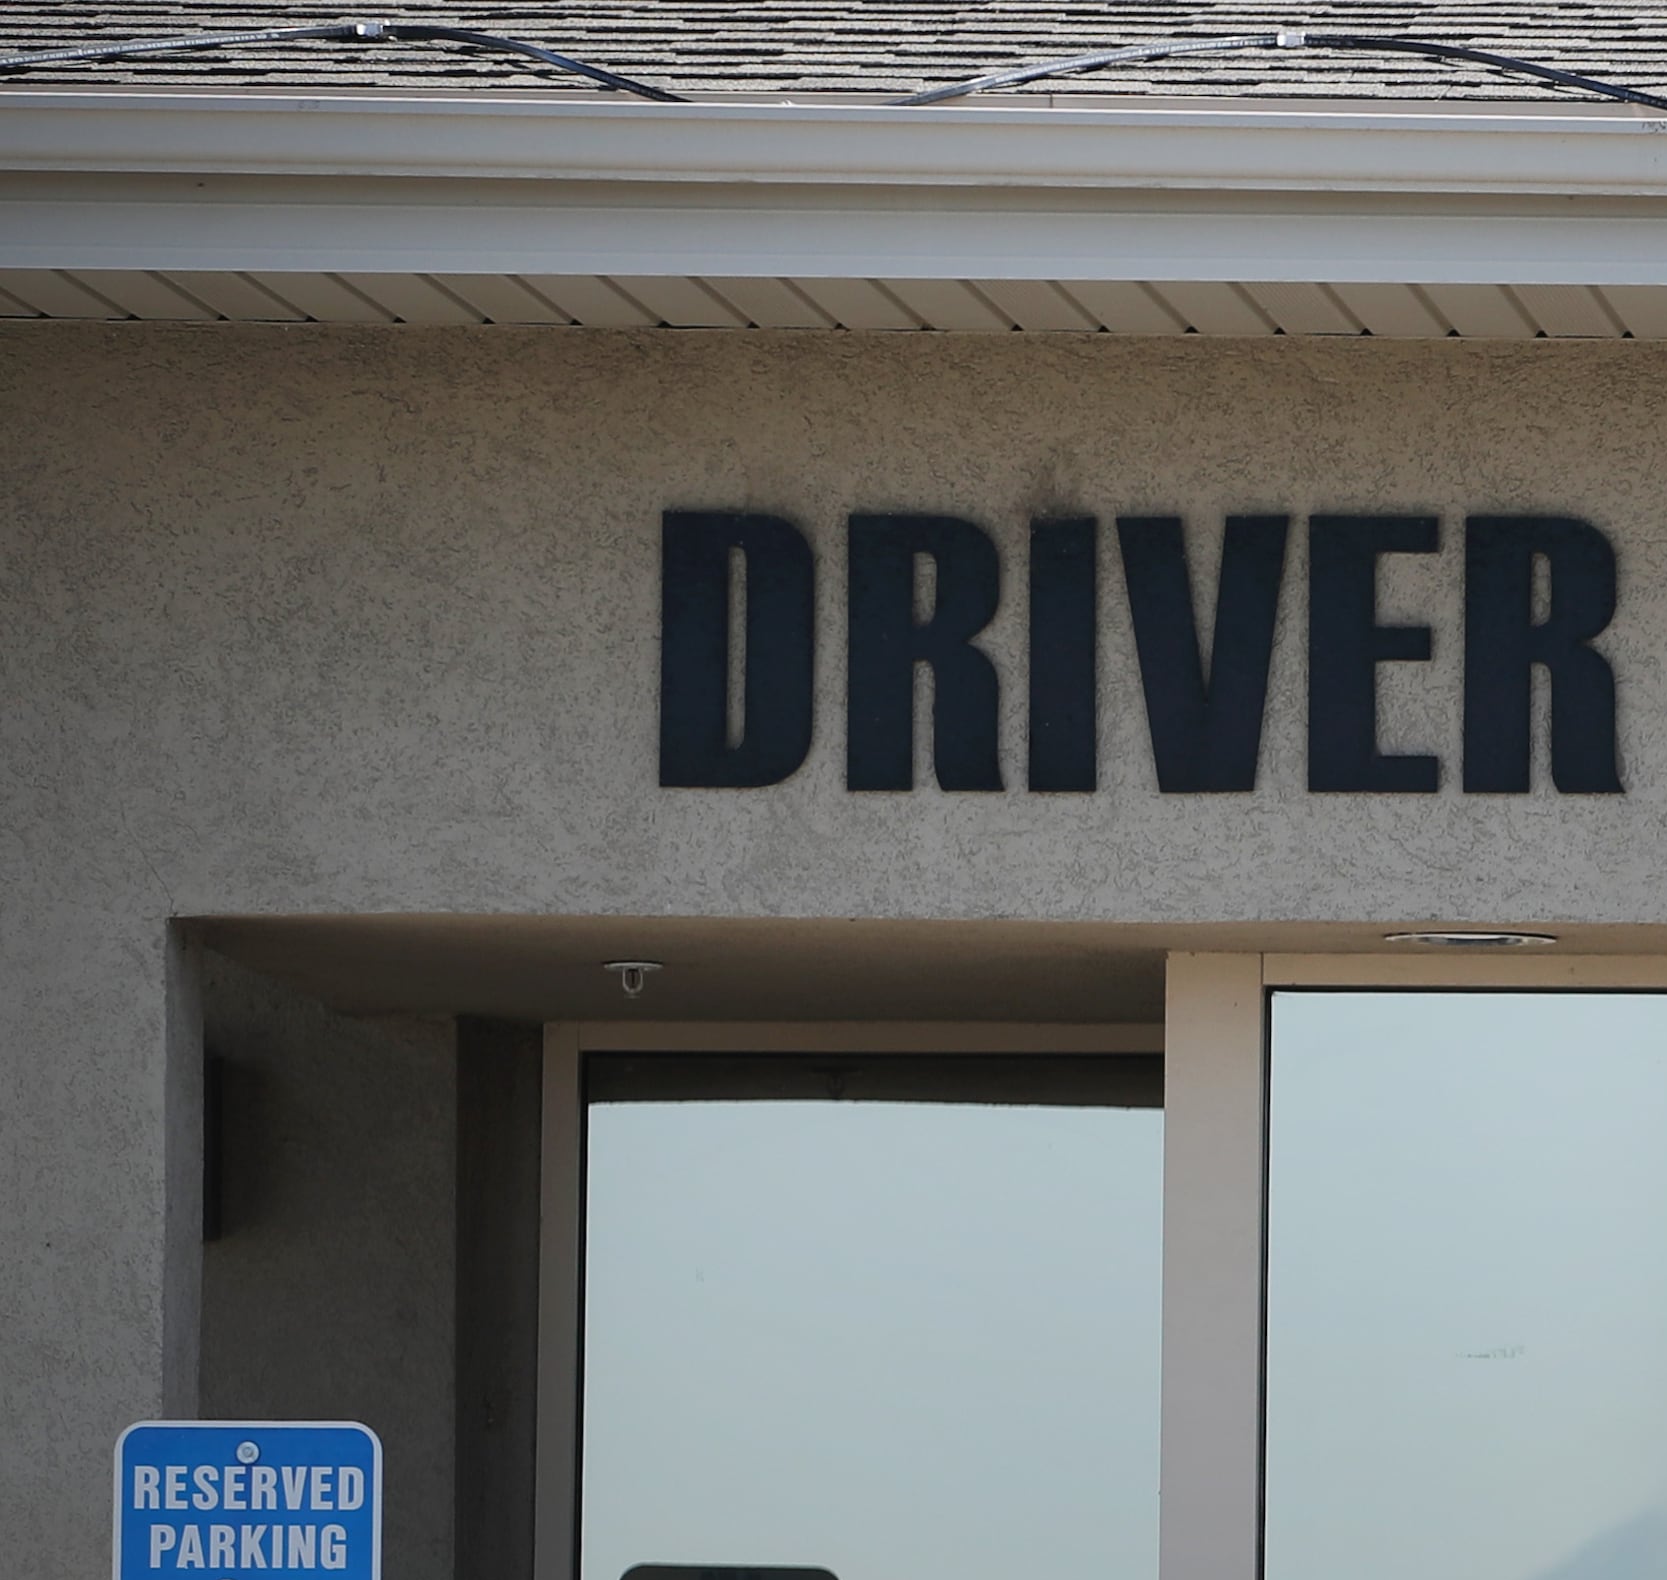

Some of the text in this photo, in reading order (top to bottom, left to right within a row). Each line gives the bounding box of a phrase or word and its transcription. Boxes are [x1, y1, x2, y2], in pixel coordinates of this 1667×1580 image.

[659, 510, 1626, 793] DRIVER
[133, 1464, 365, 1511] RESERVED
[149, 1524, 348, 1570] PARKING
